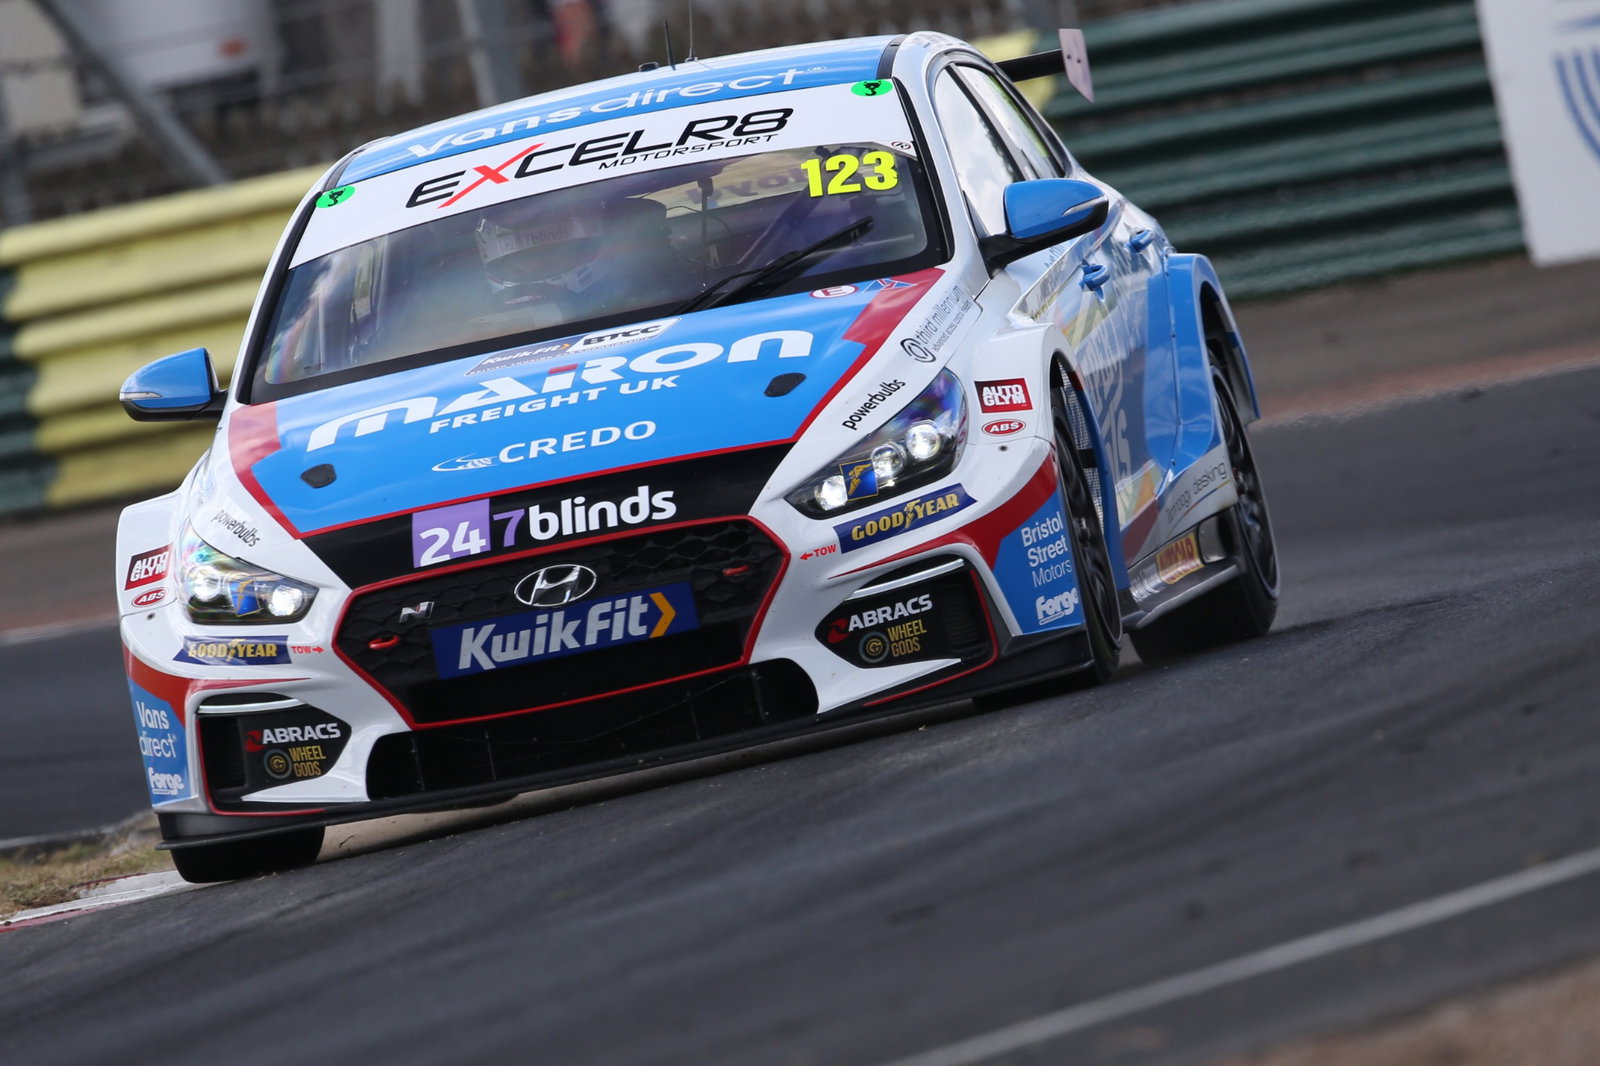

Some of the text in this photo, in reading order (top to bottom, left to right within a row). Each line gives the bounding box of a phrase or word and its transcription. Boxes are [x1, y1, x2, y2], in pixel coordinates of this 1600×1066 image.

[406, 107, 793, 208] EXCELR8
[598, 133, 779, 171] MOTORSPORT
[801, 151, 898, 198] 123
[583, 325, 662, 346] BTCC
[915, 318, 938, 345] third
[983, 384, 1024, 397] AUTO
[983, 393, 1026, 407] GLYM
[428, 374, 680, 433] FREIGHT UK
[842, 377, 906, 430] powerbulbs
[990, 422, 1020, 433] ABS
[497, 419, 657, 464] CREDO
[211, 508, 261, 548] powerbulbs
[1021, 510, 1064, 547] Bristol
[132, 551, 170, 571] AUTO
[813, 544, 837, 557] TOW
[1027, 534, 1068, 568] Street
[129, 563, 168, 582] GLYM
[1032, 559, 1073, 588] Motors
[137, 590, 166, 604] ABS
[848, 593, 933, 632] ABRACS
[887, 618, 928, 641] WHEEL
[291, 645, 312, 655] TOW
[891, 637, 921, 657] GODS
[136, 701, 170, 729] Vans
[138, 730, 177, 759] direct
[262, 722, 341, 745] ABRACS
[288, 745, 327, 763] WHEEL
[293, 760, 322, 778] GODS
